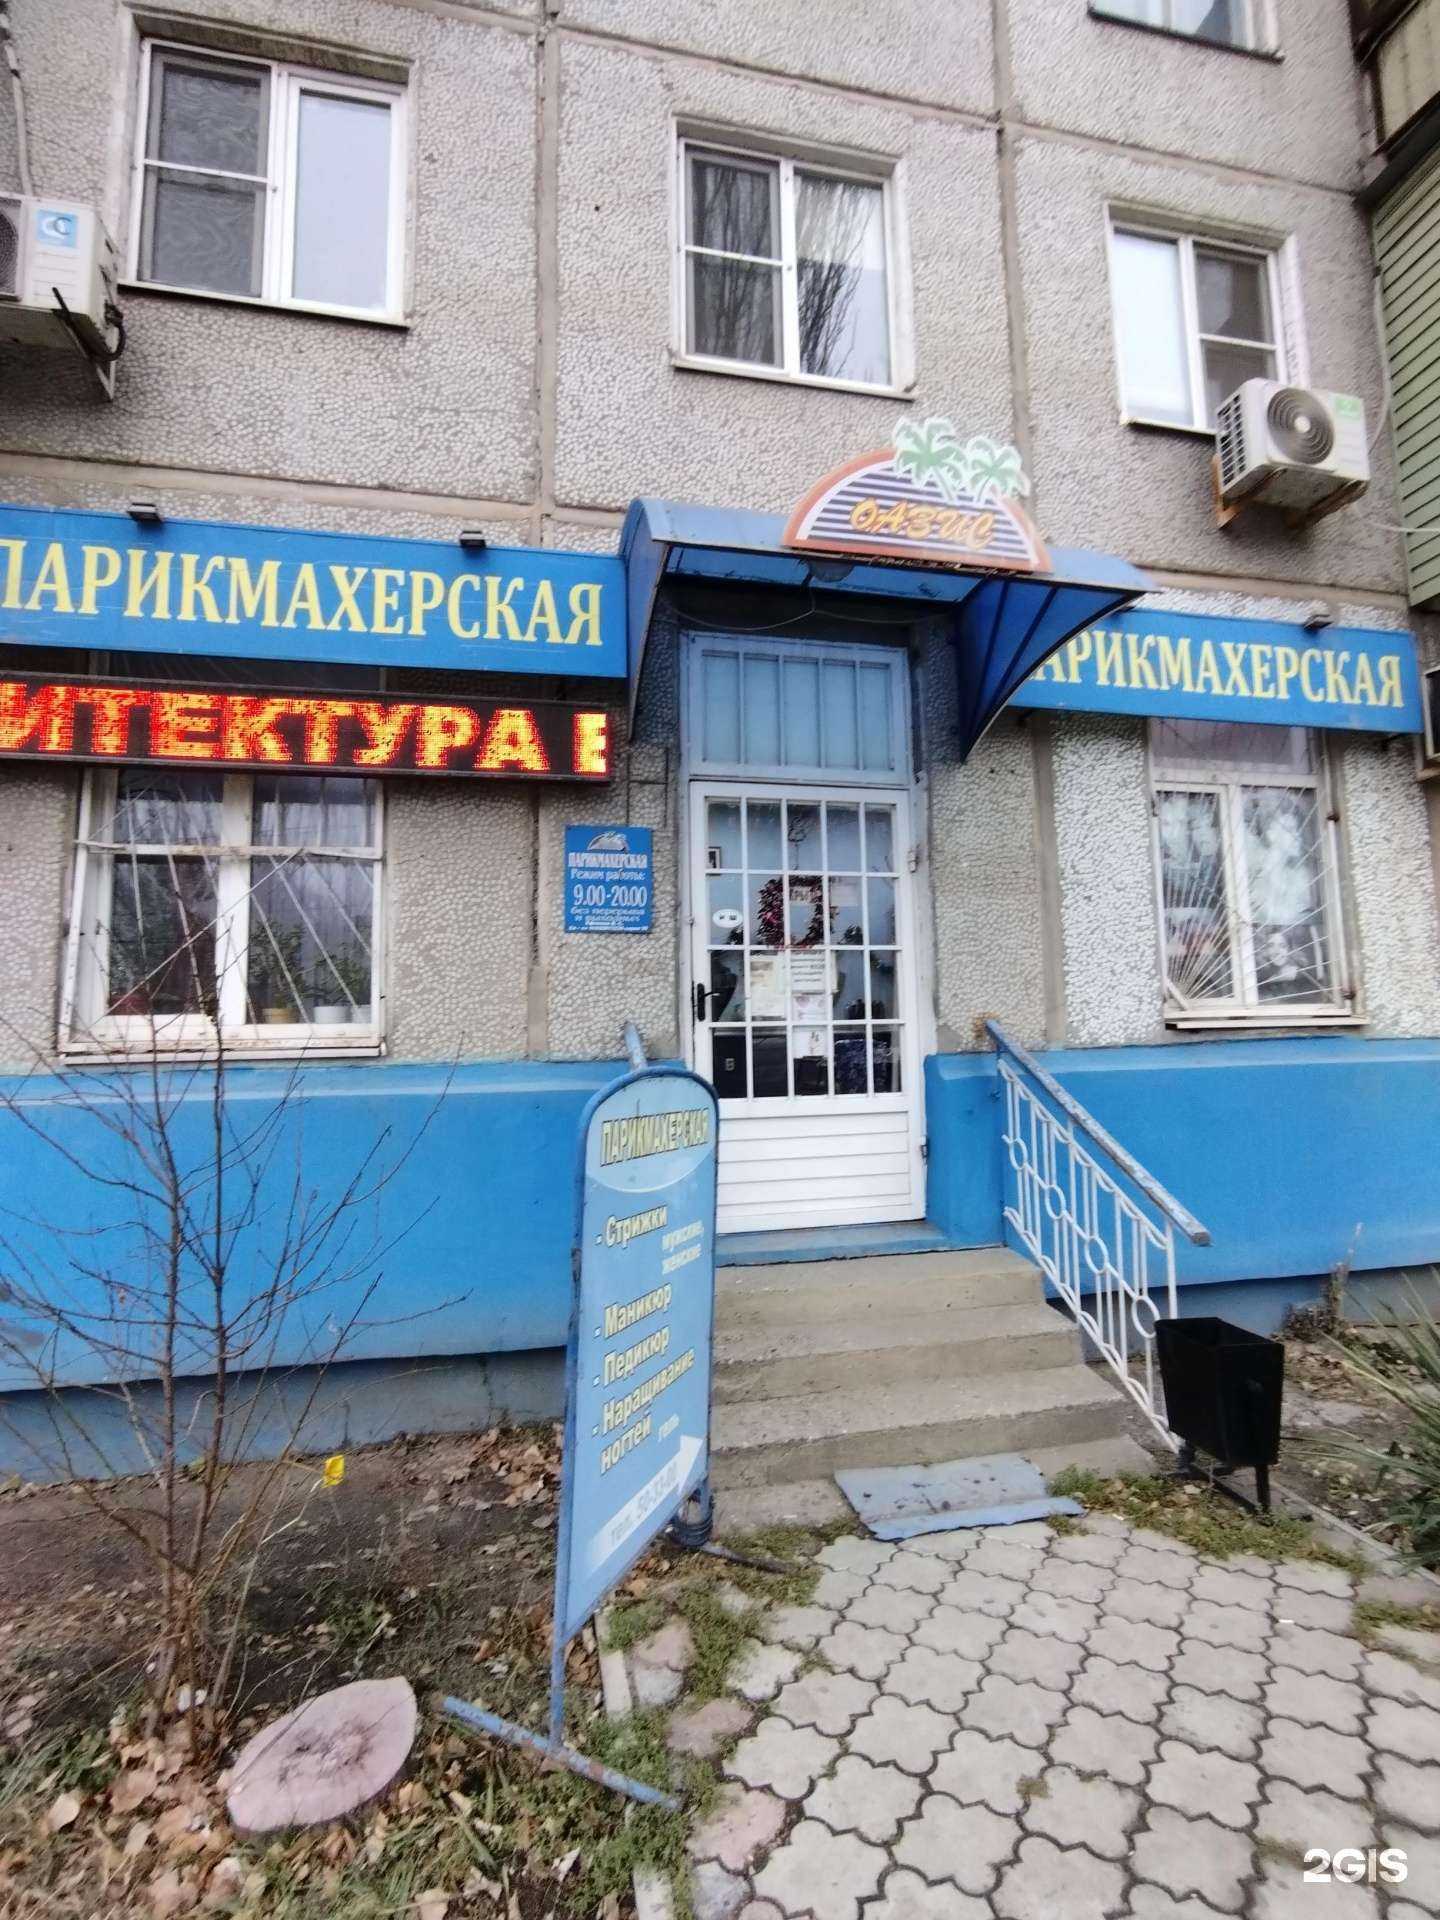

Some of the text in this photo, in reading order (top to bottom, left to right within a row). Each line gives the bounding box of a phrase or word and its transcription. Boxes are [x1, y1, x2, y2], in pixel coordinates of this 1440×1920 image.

[850, 497, 995, 550] ОАЗИС
[0, 539, 604, 646] ПАРИКМАХЕРСКАЯ
[1030, 630, 1404, 708] АРИКМАХЕРСКАЯ
[600, 1107, 709, 1167] ПАРИКМАХЕРСКАЯ
[606, 1204, 668, 1249] Стрижки
[604, 1281, 672, 1340] Маникюр
[603, 1325, 670, 1388] Педикюр
[602, 1345, 695, 1437] Наращивание
[600, 1410, 651, 1476] ногтей
